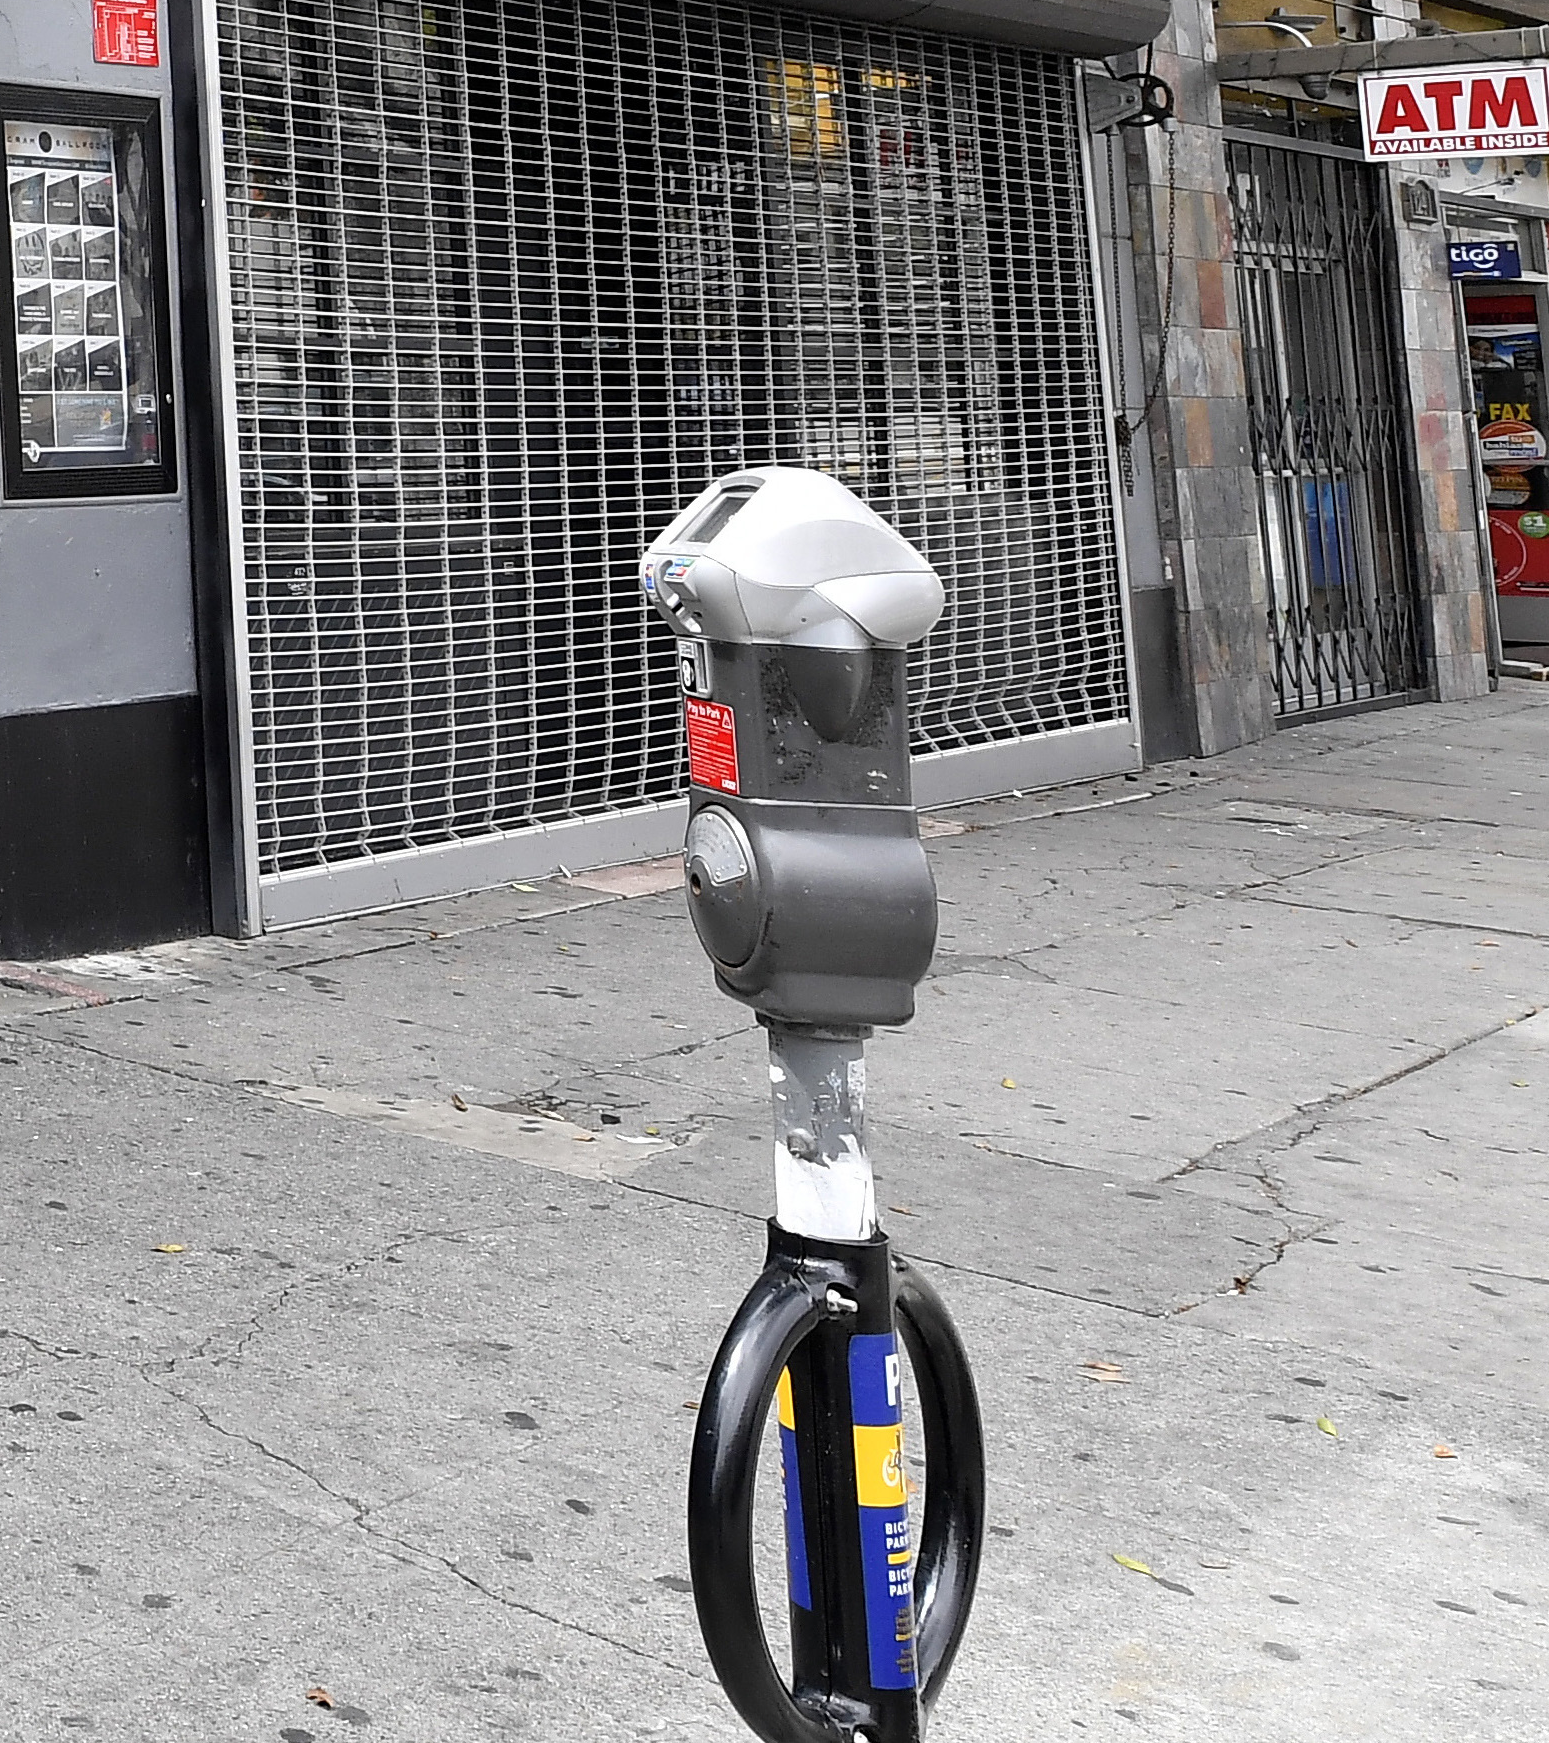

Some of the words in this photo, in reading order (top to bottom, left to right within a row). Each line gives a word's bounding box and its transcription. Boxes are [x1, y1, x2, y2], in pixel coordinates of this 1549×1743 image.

[1375, 76, 1539, 135] ATM
[1373, 136, 1476, 154] AVAILABLE
[1481, 133, 1549, 150] INSIDE
[1489, 403, 1532, 421] FAX
[687, 700, 699, 718] Pay
[706, 705, 721, 721] Park
